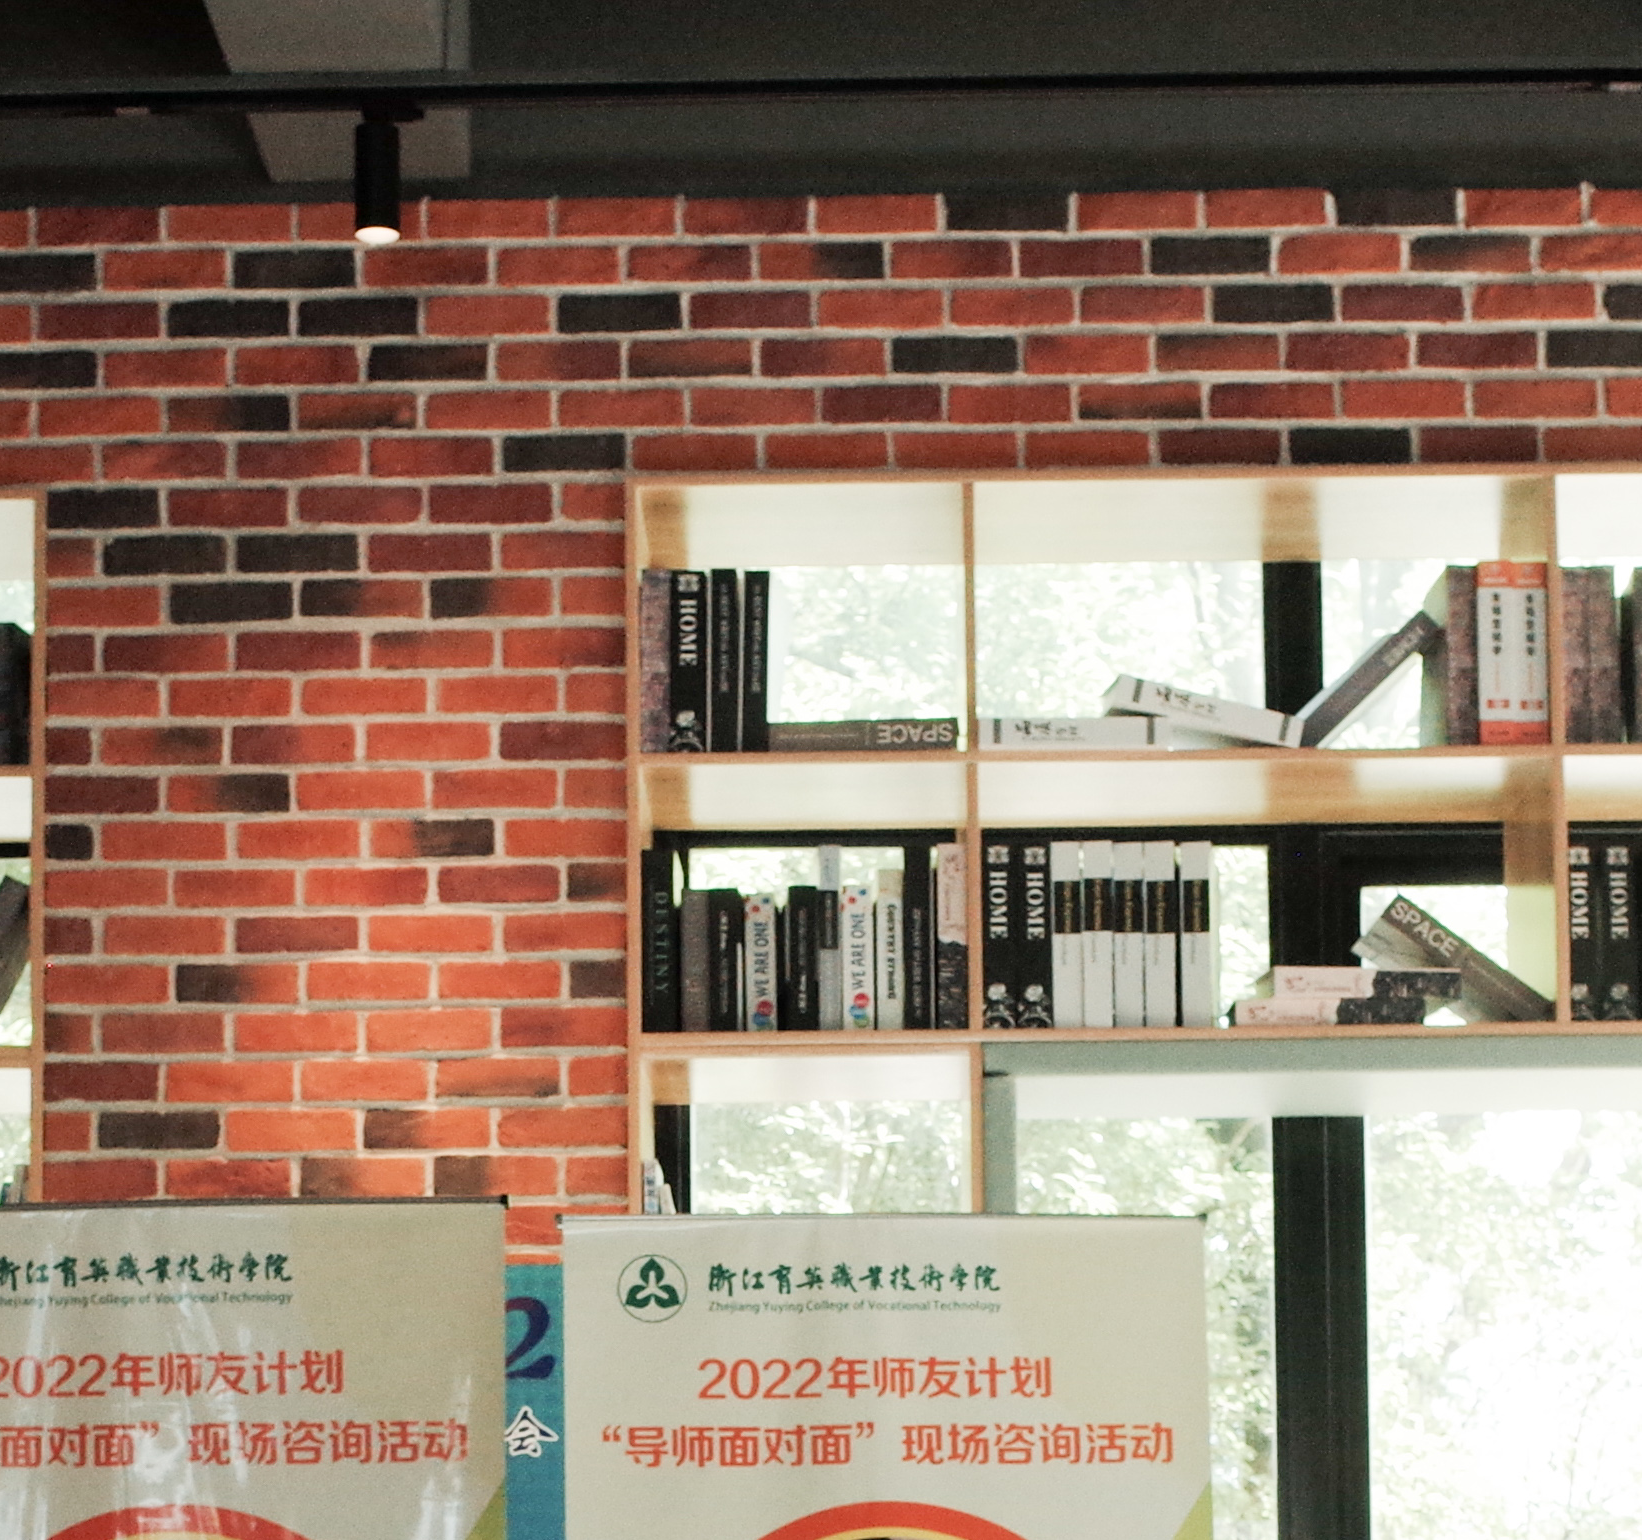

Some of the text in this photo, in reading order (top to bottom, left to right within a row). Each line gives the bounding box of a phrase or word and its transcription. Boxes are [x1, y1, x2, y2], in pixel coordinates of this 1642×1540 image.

[678, 598, 699, 668] HOME
[877, 722, 955, 744] SPACE
[988, 871, 1008, 940] HOME
[1026, 872, 1046, 940] HOME
[1388, 899, 1460, 958] SPACE
[1570, 871, 1590, 940] HOME
[1609, 871, 1629, 940] HOME
[654, 890, 669, 995] DESTINY
[753, 920, 769, 998] WE ARE ONE
[851, 912, 865, 990] WE ARE ONE
[708, 1301, 760, 1314] Zhejiang
[806, 1301, 850, 1312] College
[853, 1301, 865, 1311] of
[868, 1301, 932, 1311] Vocational
[933, 1301, 1002, 1313] Technology
[697, 1356, 1054, 1401] 2022年师友计划
[505, 1405, 559, 1457] 会
